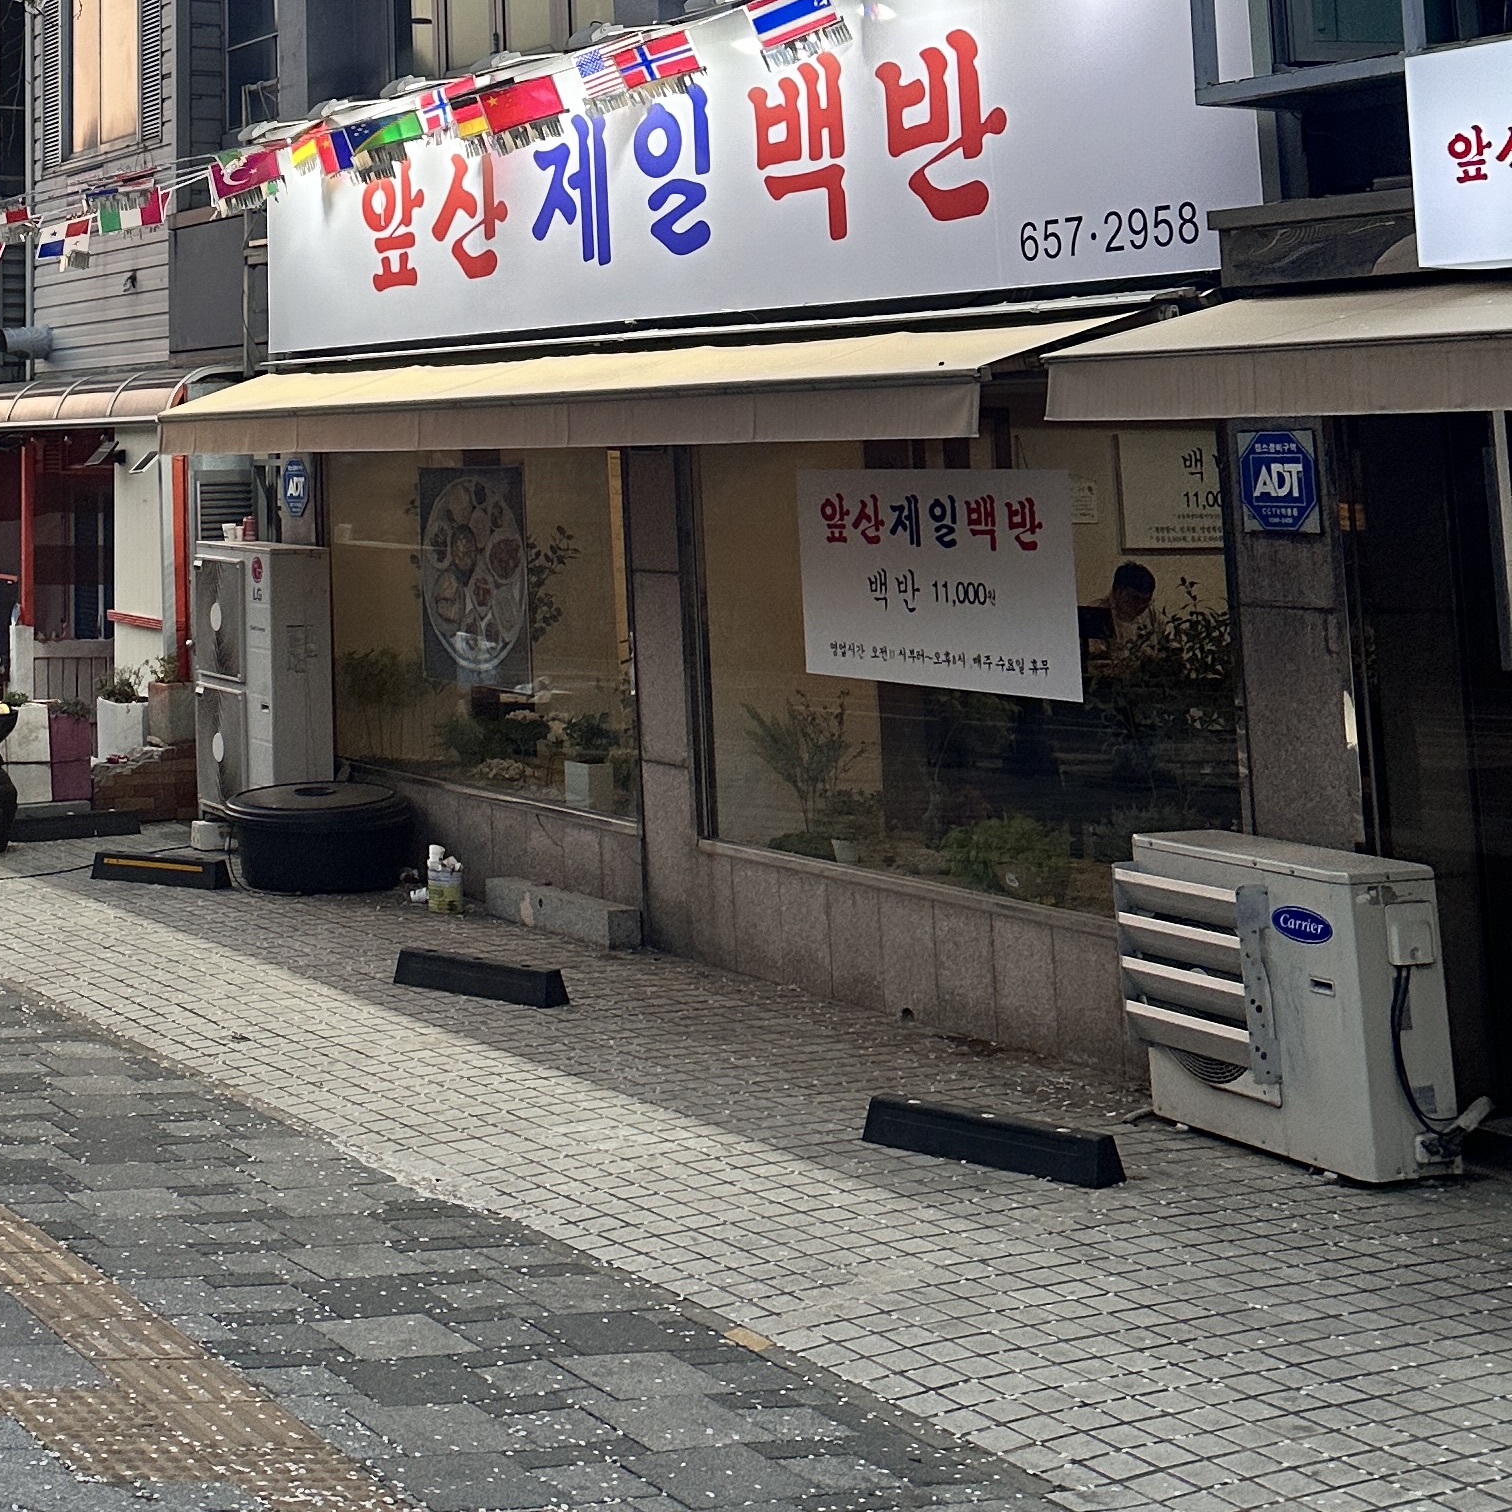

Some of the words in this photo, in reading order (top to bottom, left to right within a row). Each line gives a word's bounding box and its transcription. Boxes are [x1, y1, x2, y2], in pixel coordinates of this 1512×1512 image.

[287, 476, 305, 497] ADT
[1253, 463, 1303, 497] ADT
[252, 586, 263, 601] LG
[1279, 913, 1324, 936] Carrier
